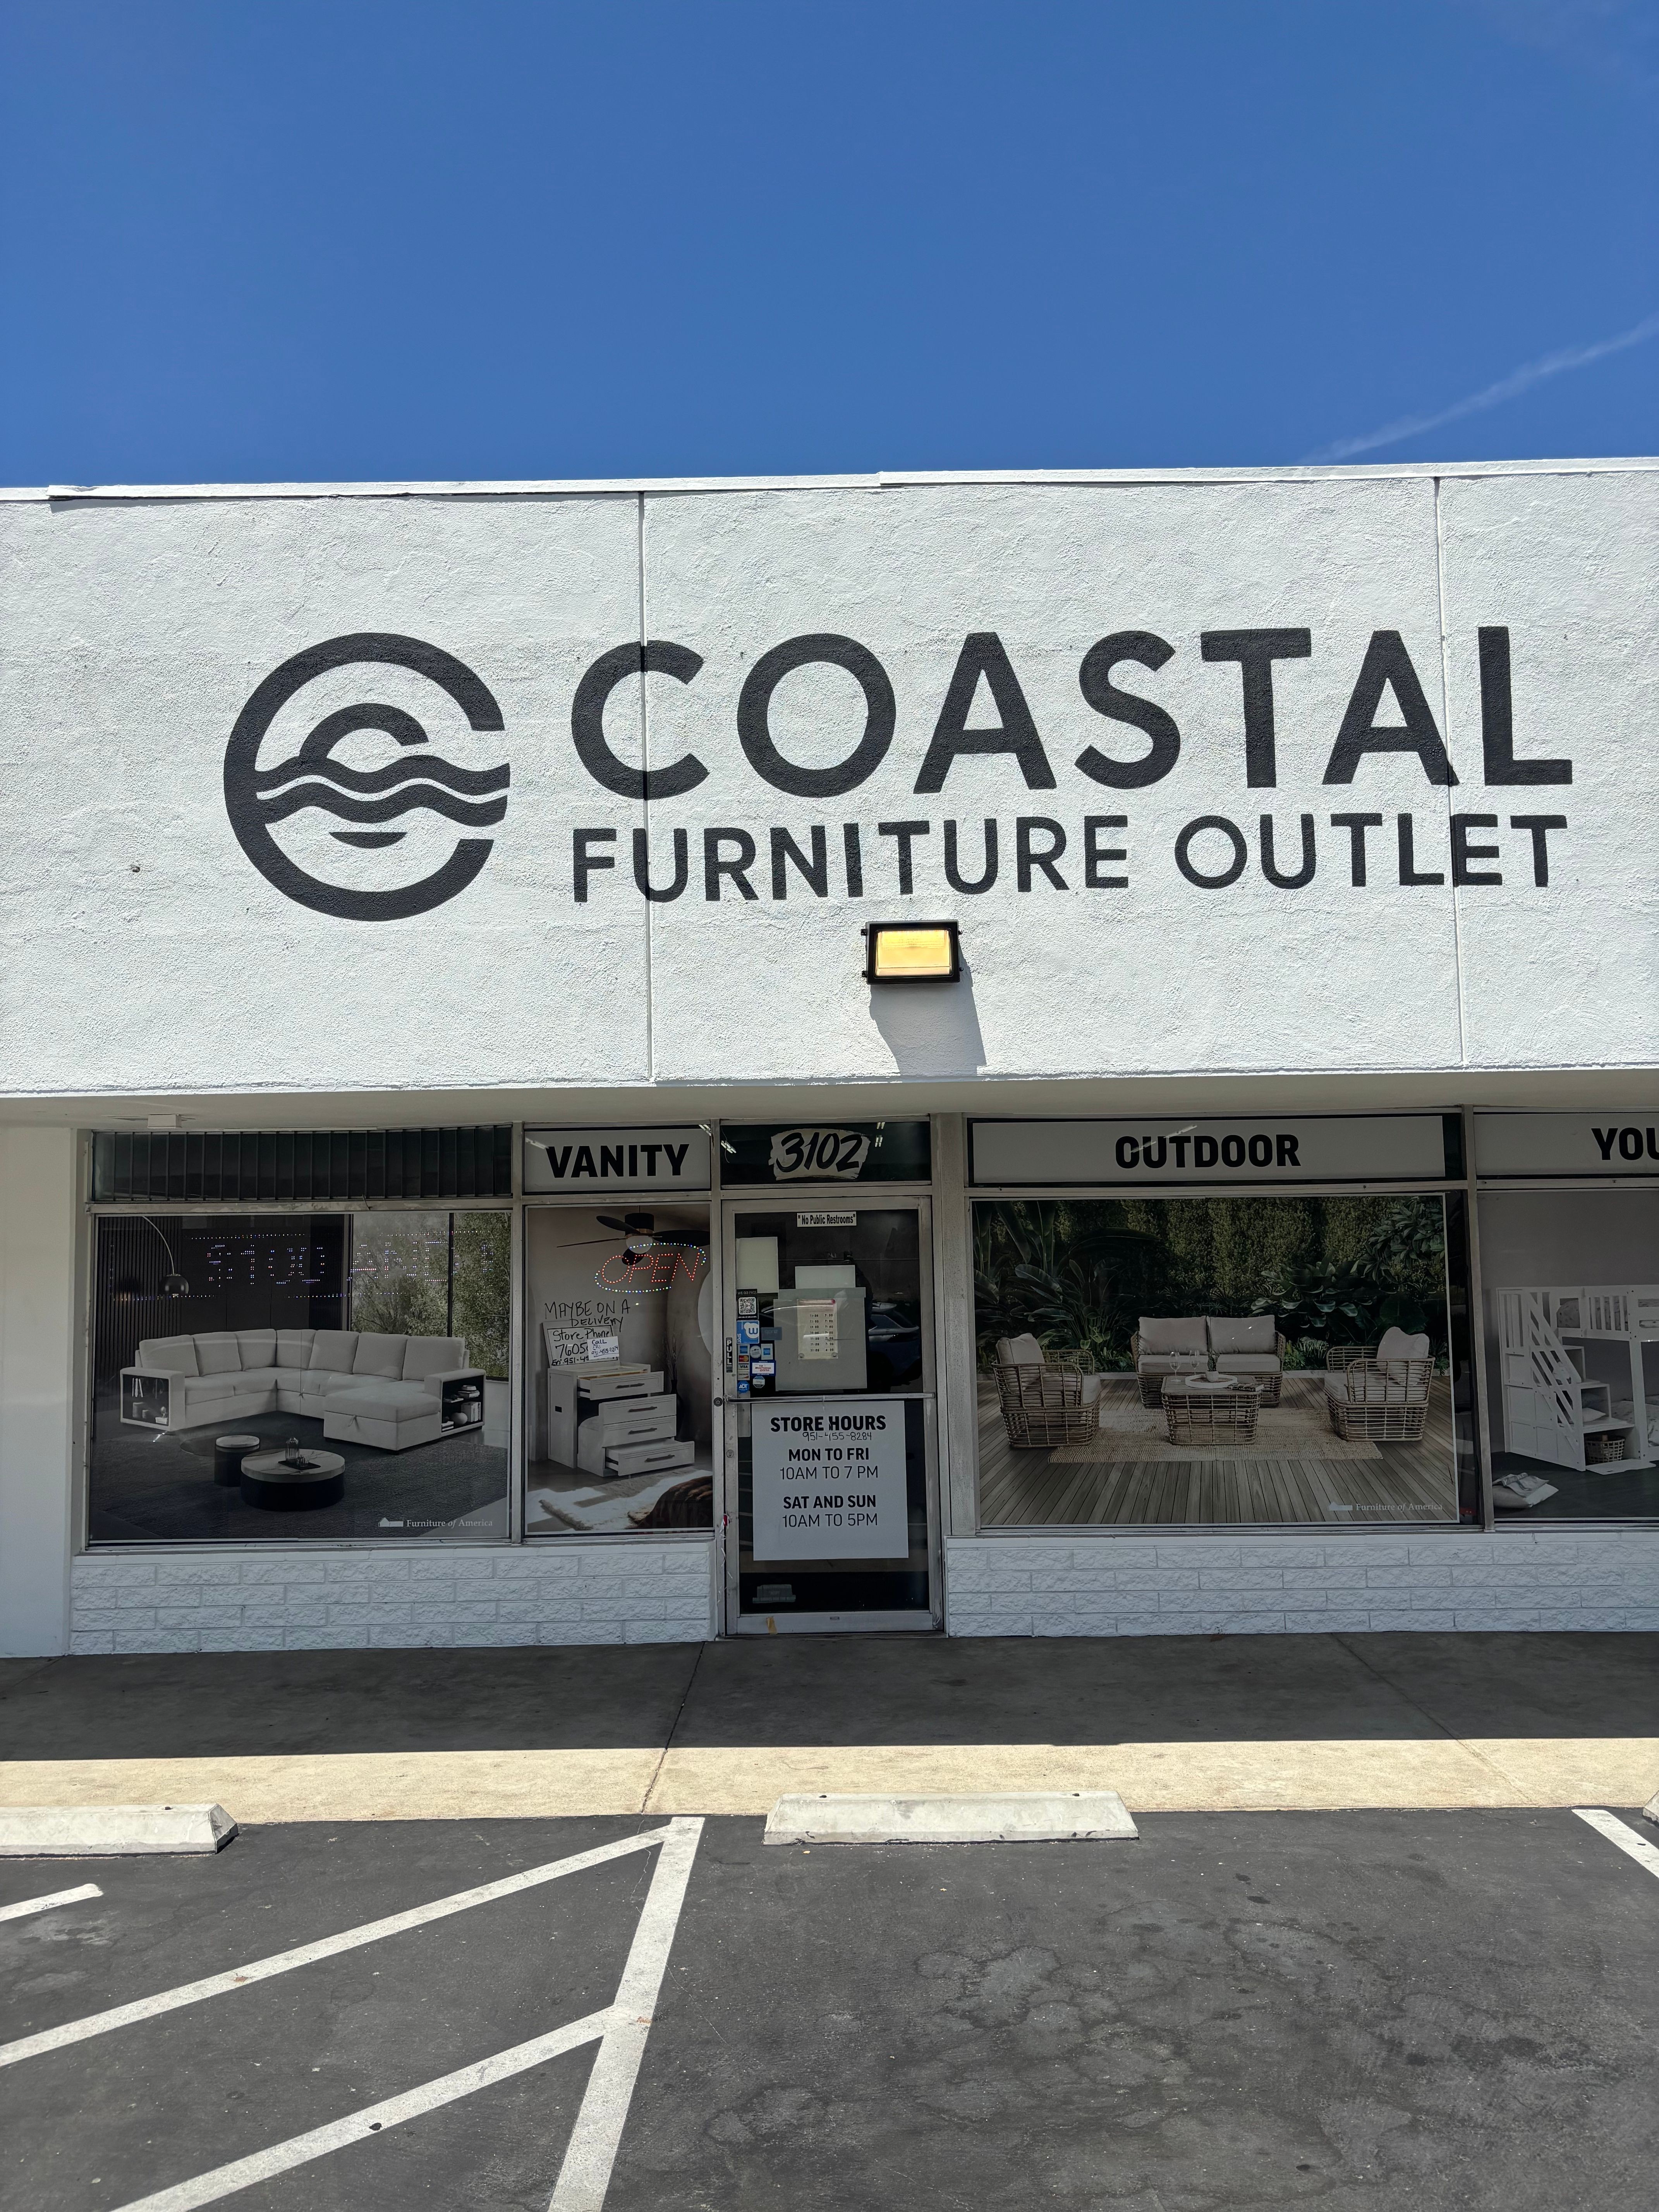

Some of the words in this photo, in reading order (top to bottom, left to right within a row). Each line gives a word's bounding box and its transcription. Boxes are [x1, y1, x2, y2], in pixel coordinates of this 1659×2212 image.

[571, 627, 1572, 800] COASTAL
[573, 815, 1128, 903] FURNITURE
[1175, 813, 1567, 889] OUTLET
[776, 1132, 862, 1172] 3102
[1116, 1135, 1301, 1169] OUTDOOR
[546, 1144, 689, 1178] VANITY
[810, 1214, 825, 1224] Public
[601, 1253, 700, 1284] OPEN
[544, 1300, 592, 1319] MAYBE
[597, 1300, 615, 1316] ON
[622, 1299, 630, 1314] A
[553, 1329, 584, 1341] Store
[555, 1342, 588, 1358] 7605
[771, 1416, 824, 1432] STORE
[829, 1415, 886, 1431] HOURS
[802, 1432, 872, 1441] 951-455-8284
[789, 1448, 821, 1461] MON
[825, 1448, 842, 1461] TO
[847, 1448, 869, 1460] FRI
[780, 1467, 817, 1480] 10AM
[822, 1466, 840, 1479] TO
[844, 1466, 852, 1479] 7
[857, 1465, 878, 1478] PM
[783, 1496, 809, 1509] SAT
[813, 1495, 843, 1508] AND
[848, 1495, 876, 1508] SUN
[1398, 1503, 1406, 1512] of
[448, 1520, 457, 1528] of
[782, 1514, 819, 1527] 10AM
[825, 1513, 842, 1527] TO
[848, 1513, 877, 1526] 5PM
